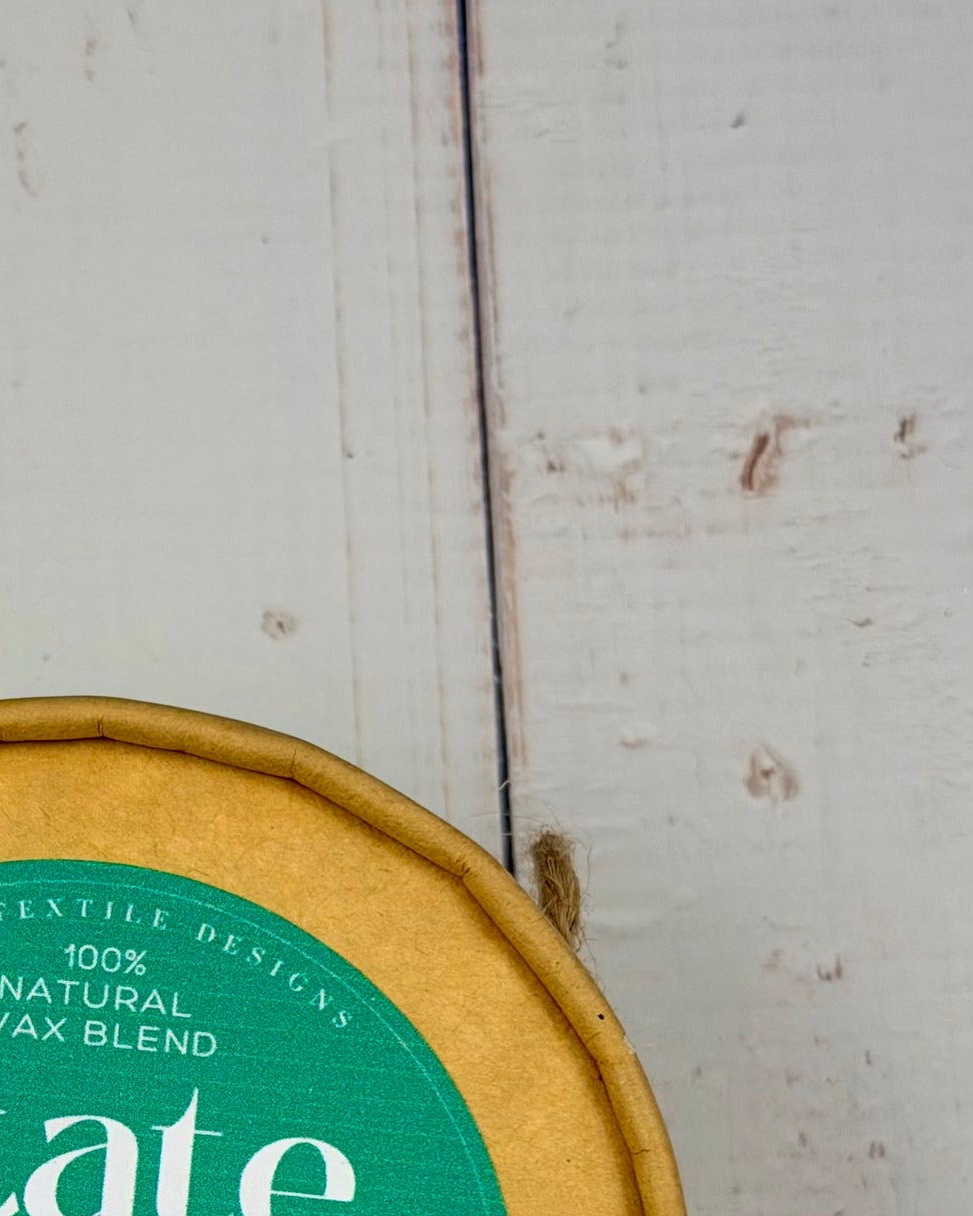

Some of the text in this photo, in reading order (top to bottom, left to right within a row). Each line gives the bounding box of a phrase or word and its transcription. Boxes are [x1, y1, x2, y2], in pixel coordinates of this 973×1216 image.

[64, 943, 146, 976] 100%
[197, 923, 352, 1029] DESIGNS
[0, 975, 192, 1018] NATURAL
[84, 1019, 217, 1058] BLEND
